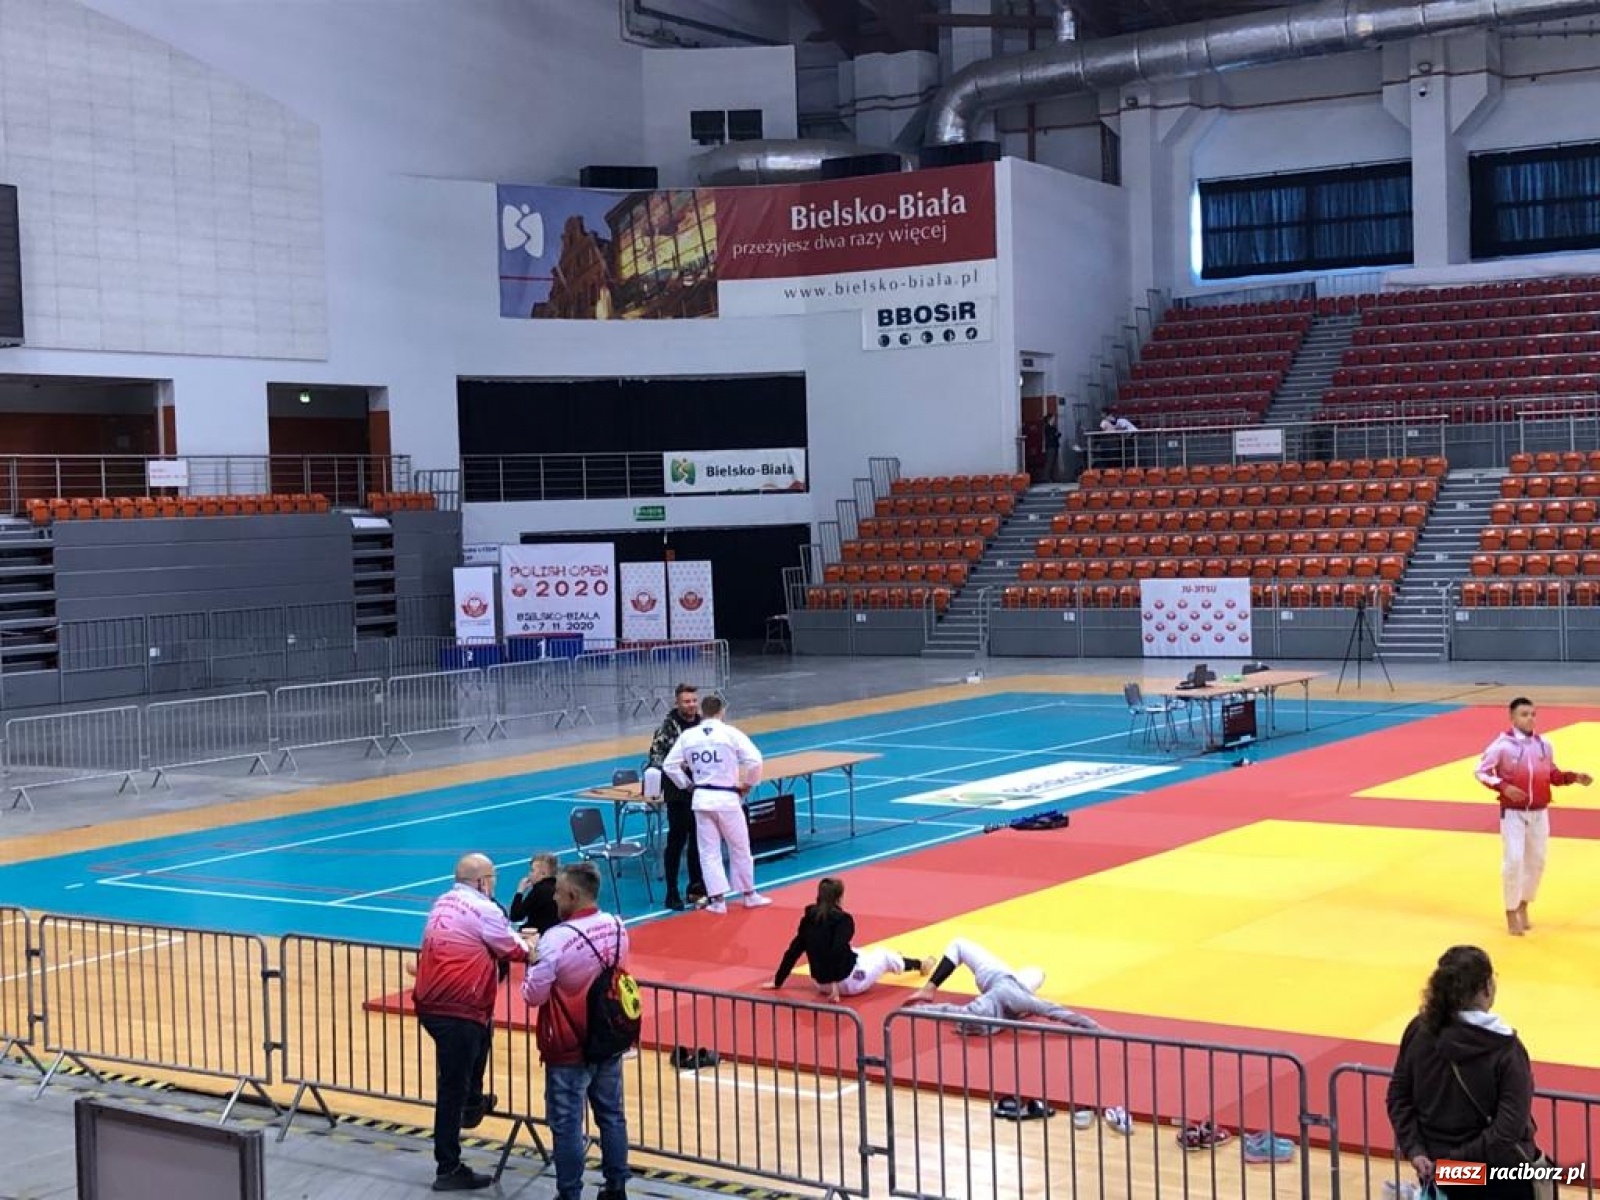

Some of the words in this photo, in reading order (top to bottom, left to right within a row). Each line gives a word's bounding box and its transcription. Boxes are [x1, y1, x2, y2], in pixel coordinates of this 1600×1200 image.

[790, 187, 967, 231] Bielsko-Biała
[732, 238, 810, 260] przeżyjesz
[814, 233, 846, 249] dwa
[849, 230, 884, 248] razy
[888, 219, 947, 244] więcej
[877, 301, 976, 328] BBOSiR
[510, 565, 567, 578] POLISH
[568, 564, 609, 577] OPEN
[535, 580, 608, 597] 2020
[691, 749, 723, 764] POL
